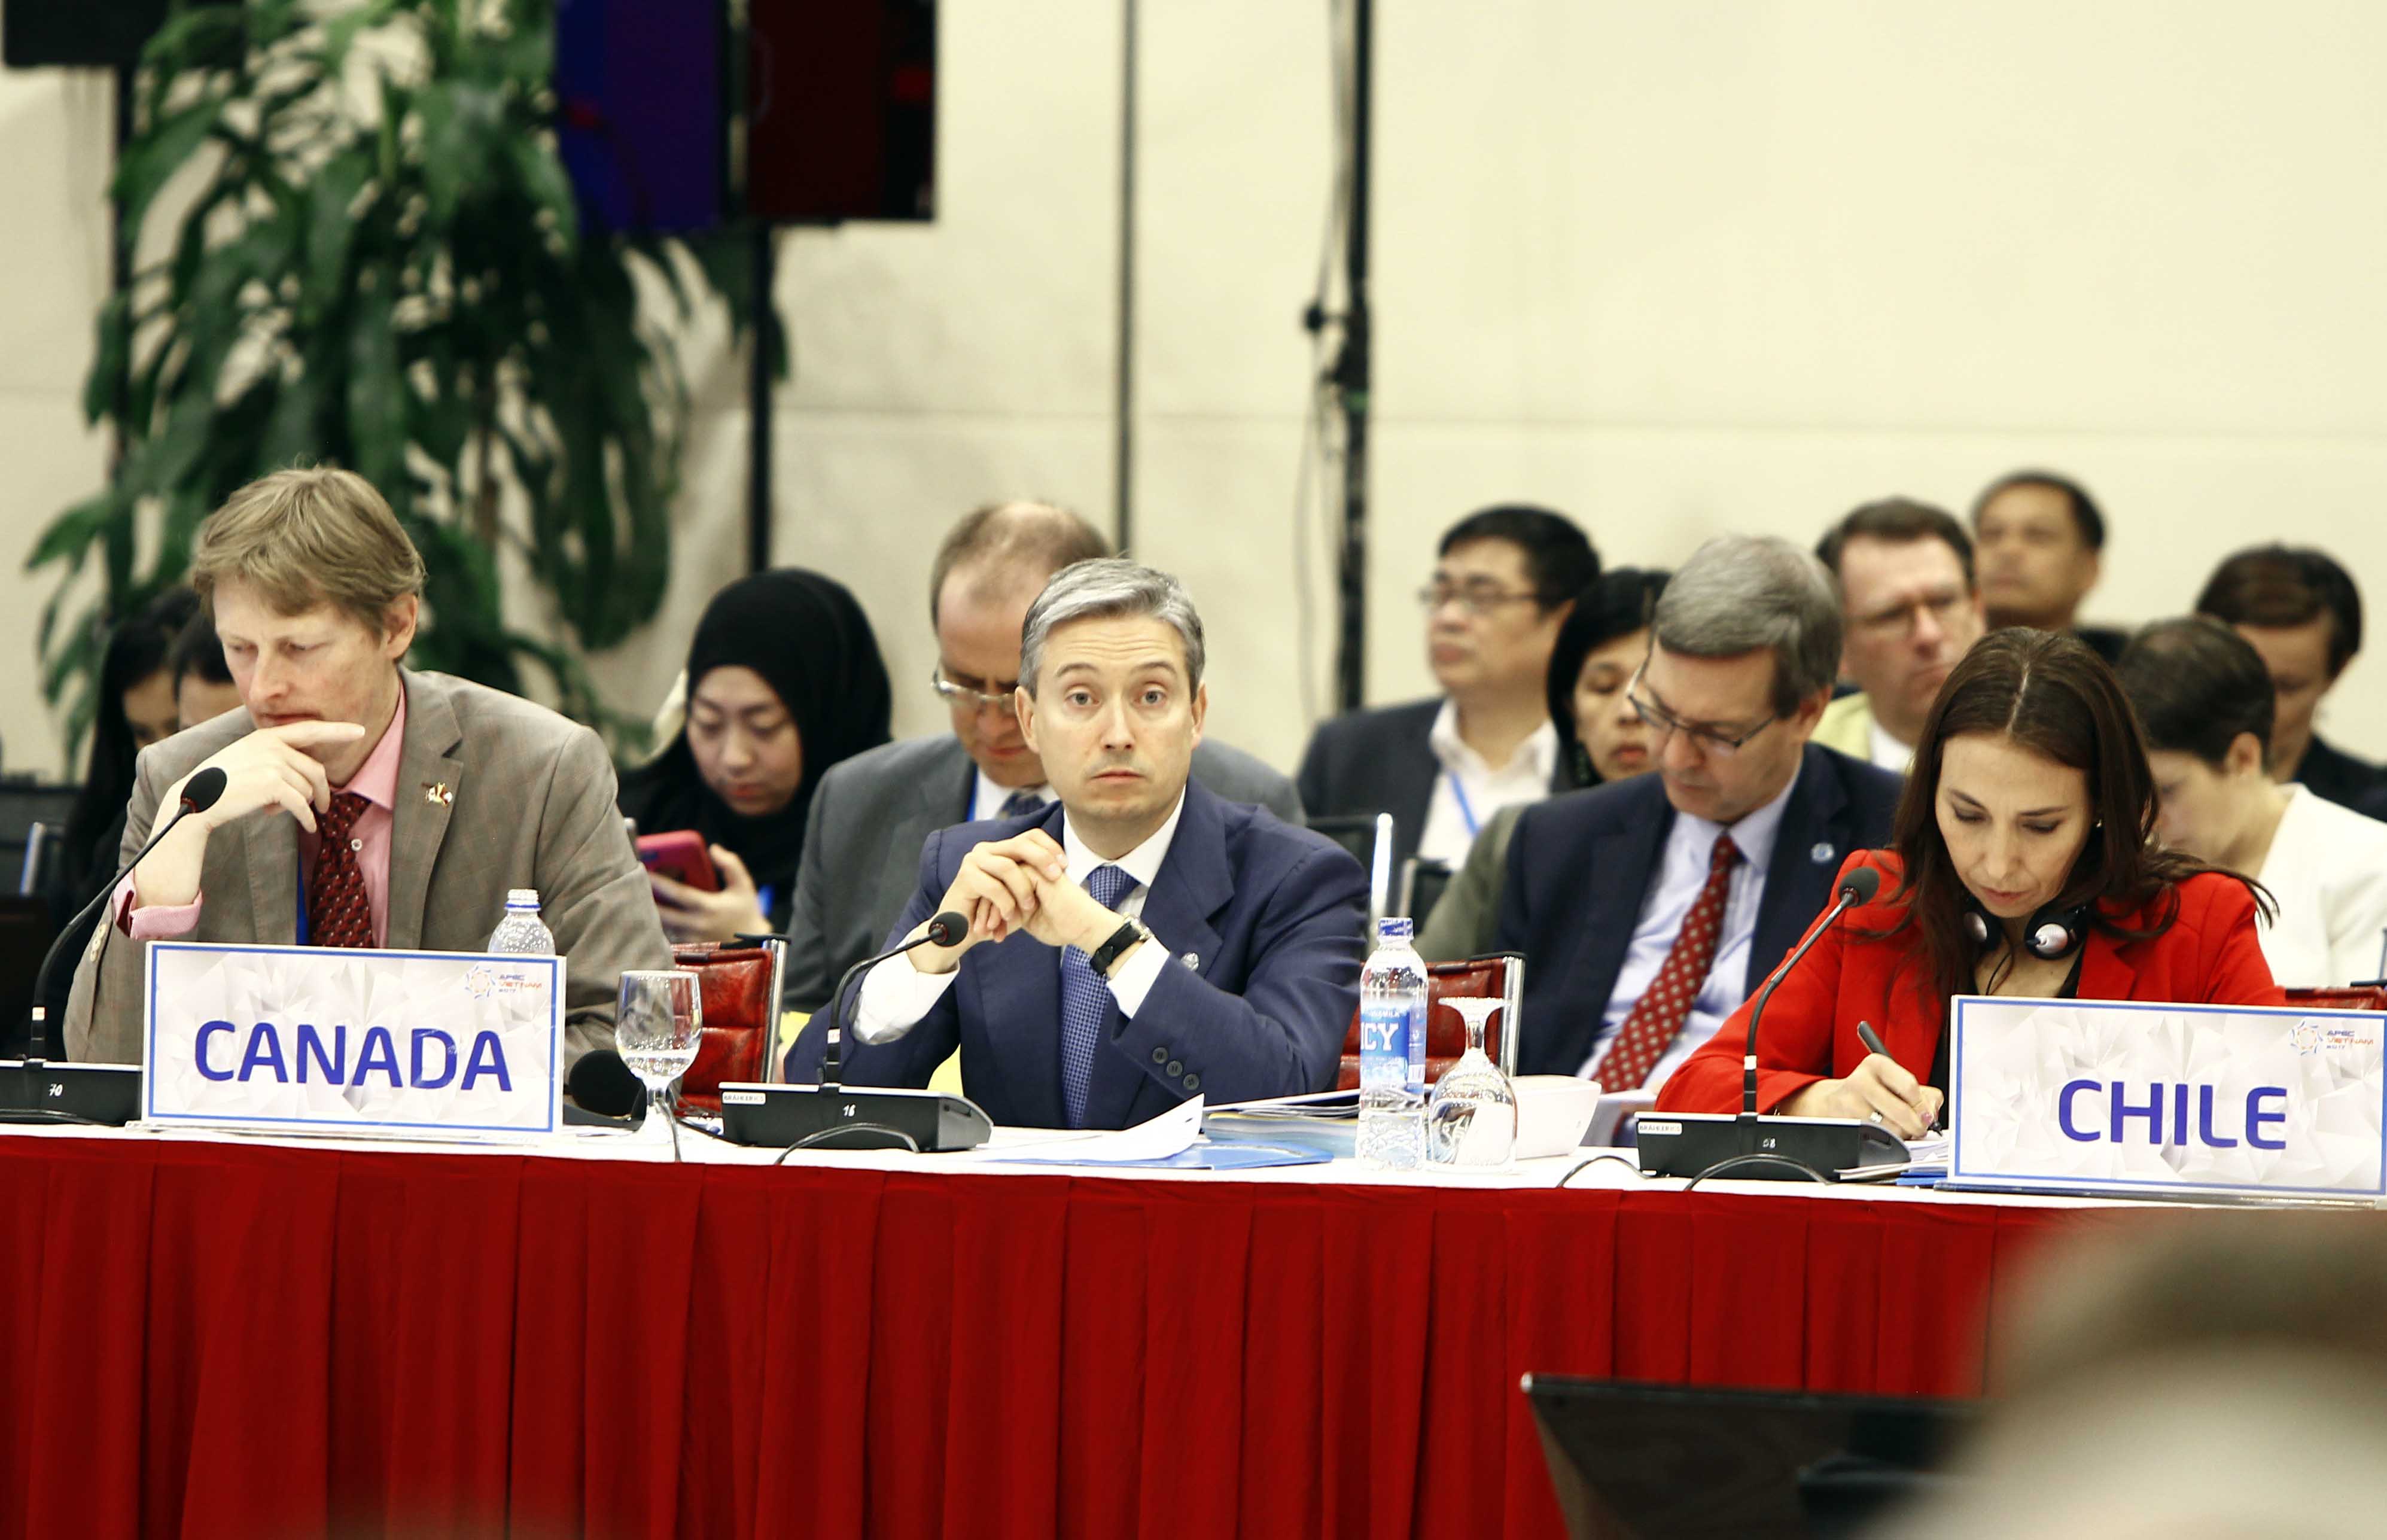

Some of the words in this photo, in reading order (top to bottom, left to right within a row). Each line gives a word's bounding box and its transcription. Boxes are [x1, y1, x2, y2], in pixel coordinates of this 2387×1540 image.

[194, 1019, 513, 1092] CANADA
[49, 1084, 63, 1096] 70
[843, 1104, 856, 1117] 16
[2059, 1079, 2288, 1150] CHILE
